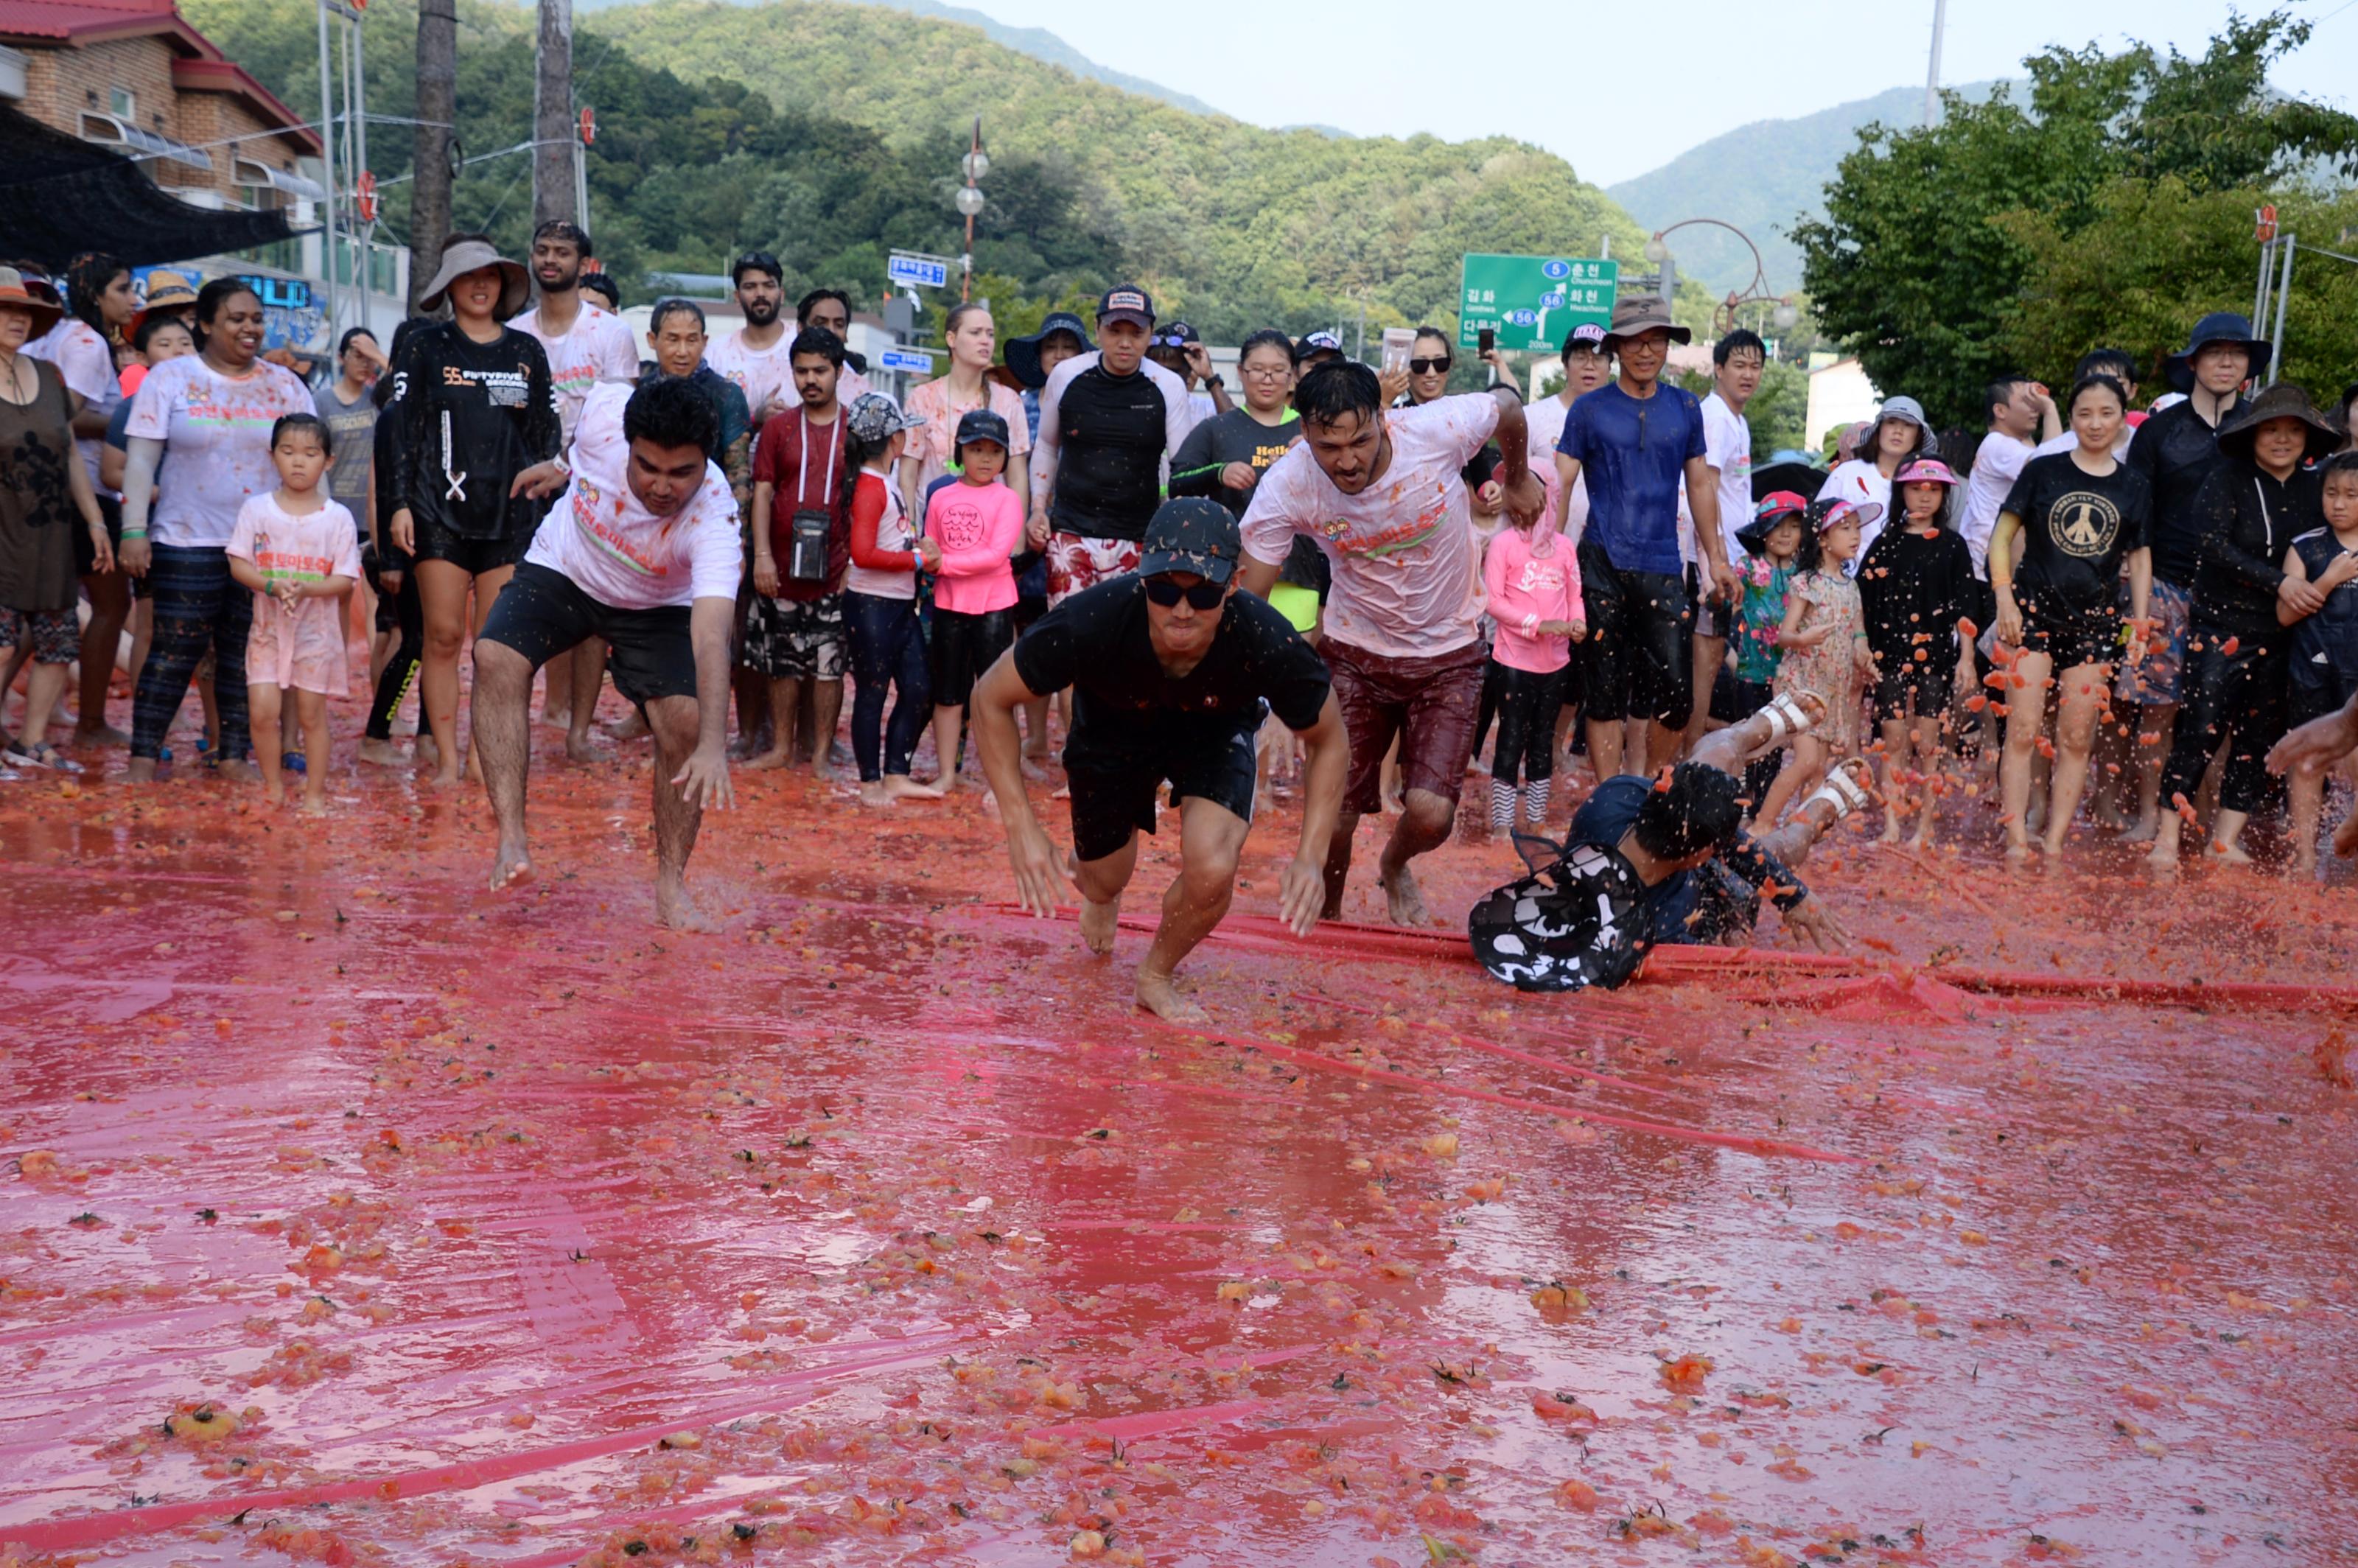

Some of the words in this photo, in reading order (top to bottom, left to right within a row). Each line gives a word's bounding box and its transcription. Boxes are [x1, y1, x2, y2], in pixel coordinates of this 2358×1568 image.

[1551, 264, 1561, 276] 5
[1571, 277, 1612, 286] Chuncheon
[1544, 295, 1560, 306] 56
[1570, 304, 1609, 313] Hwacheon
[1516, 312, 1532, 323] 56
[1528, 340, 1554, 349] 200m
